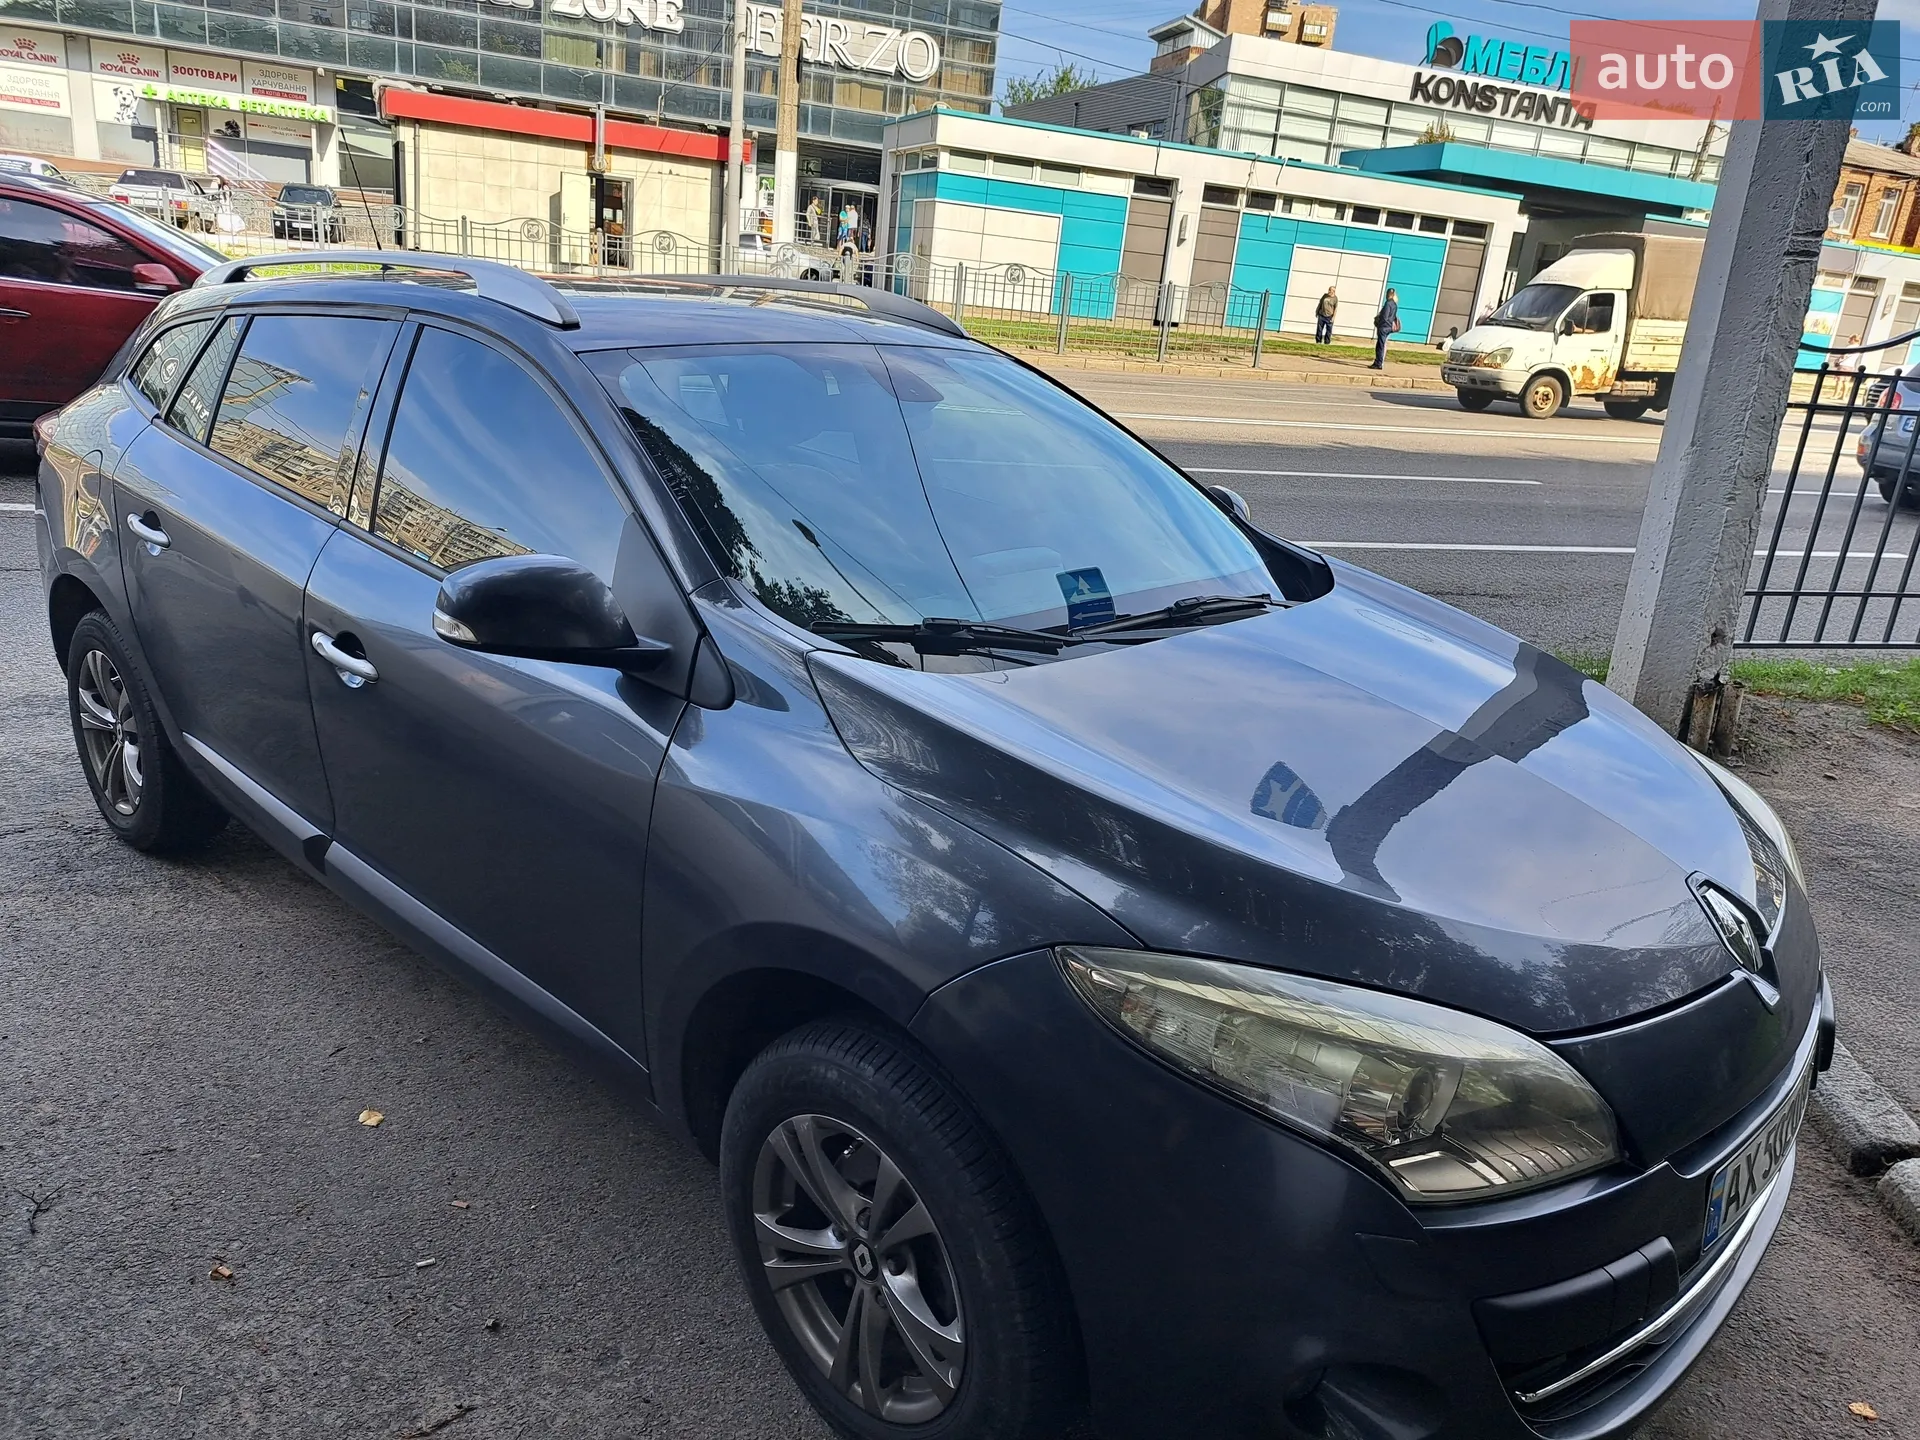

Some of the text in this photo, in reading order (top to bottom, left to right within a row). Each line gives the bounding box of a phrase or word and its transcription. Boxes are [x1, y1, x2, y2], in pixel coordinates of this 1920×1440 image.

[26, 52, 57, 63] CANIN
[100, 62, 160, 78] ROYAL CANIN
[172, 65, 238, 83] ЗООТОВАРИ
[259, 69, 299, 82] ЗДОРОВЕ
[6, 74, 50, 88] ЗДОРОВЕ
[251, 78, 307, 93] ХАРЧУВАННЯ
[166, 89, 329, 122] АПТЕКА ВЕТАПТЕКА
[1409, 72, 1598, 131] KONSTANTA
[1721, 1141, 1762, 1224] AX
